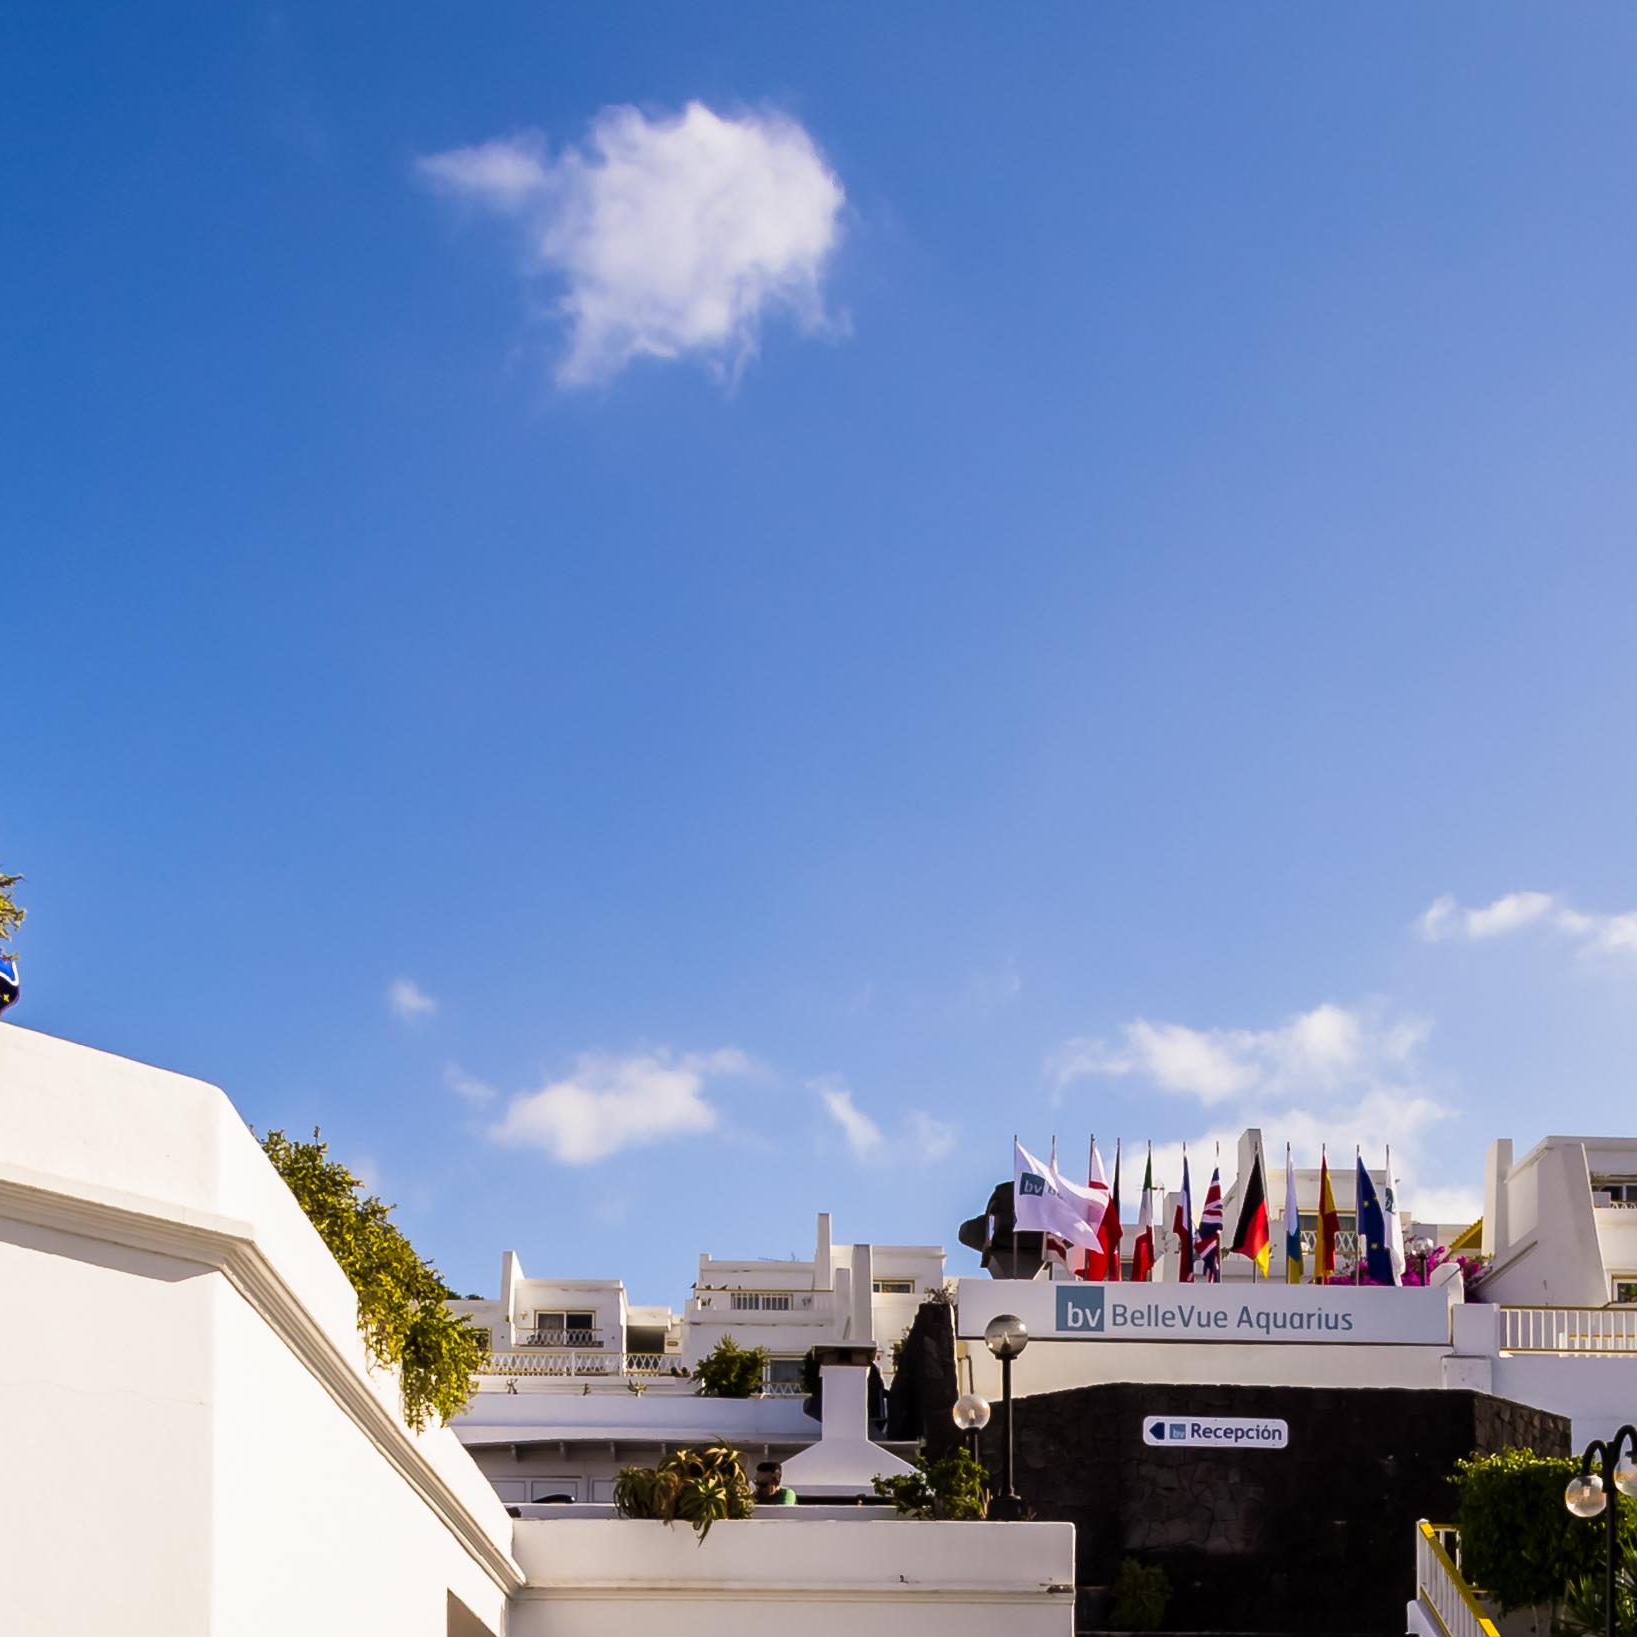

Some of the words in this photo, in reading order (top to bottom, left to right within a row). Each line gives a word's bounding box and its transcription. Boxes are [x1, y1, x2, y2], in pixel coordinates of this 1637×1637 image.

[1067, 1302, 1101, 1327] bv
[1112, 1303, 1228, 1328] BelleVue
[1237, 1306, 1354, 1335] Aquarius
[1191, 1422, 1283, 1443] Recepción
